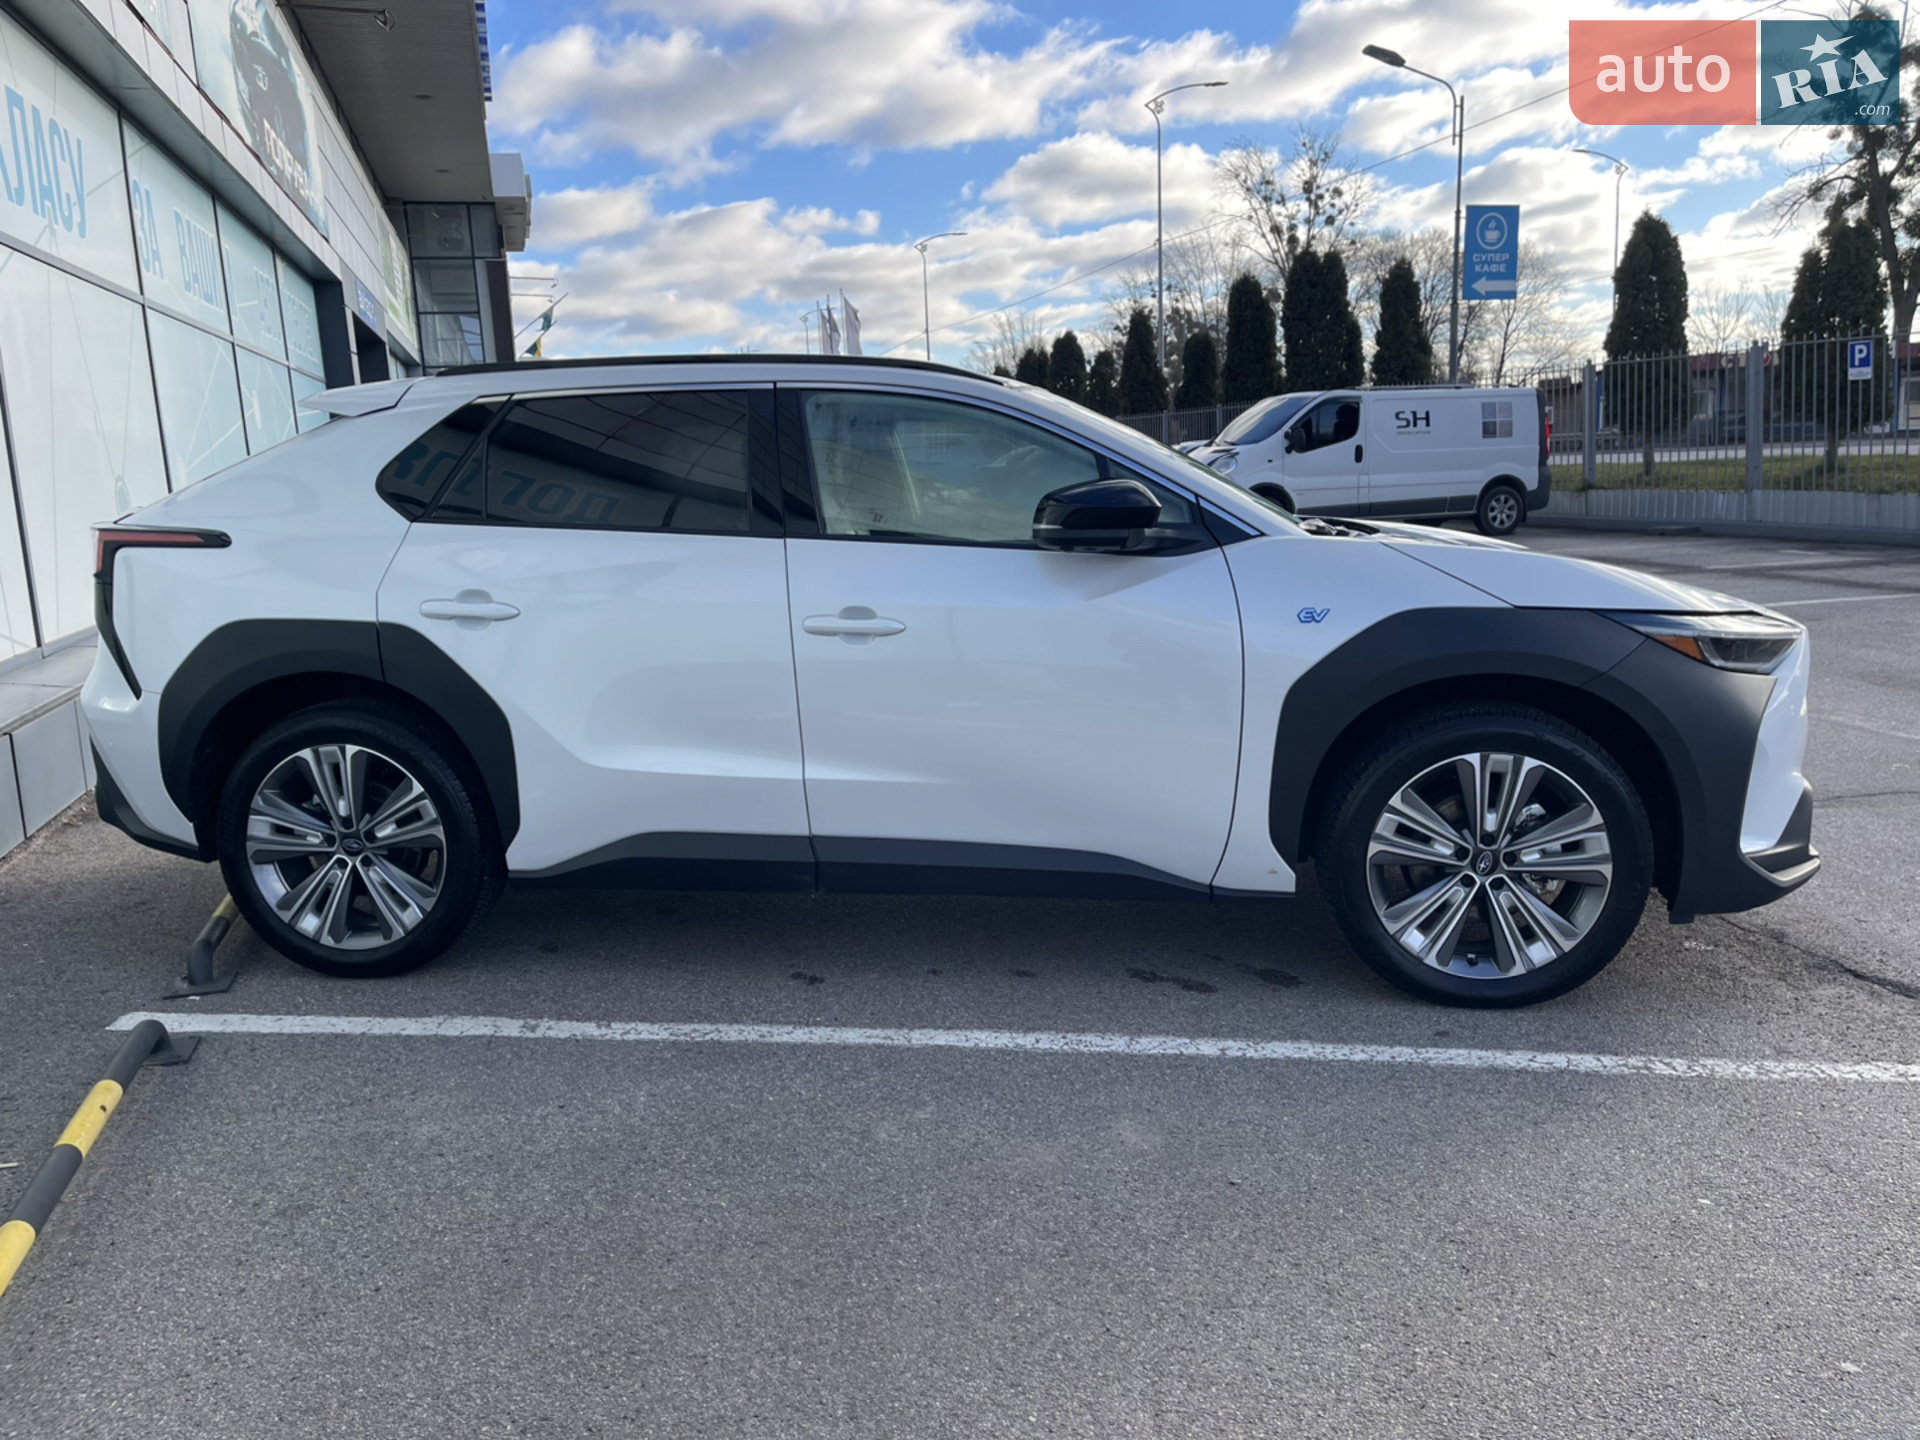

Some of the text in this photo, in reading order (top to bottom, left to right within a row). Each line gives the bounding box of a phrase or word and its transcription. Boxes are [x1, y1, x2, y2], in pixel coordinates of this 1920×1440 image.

[1472, 253, 1510, 262] СУПЕР
[1474, 263, 1507, 273] КАФЕ
[1854, 344, 1868, 366] P
[1394, 410, 1430, 429] SH
[1296, 607, 1331, 624] EV
